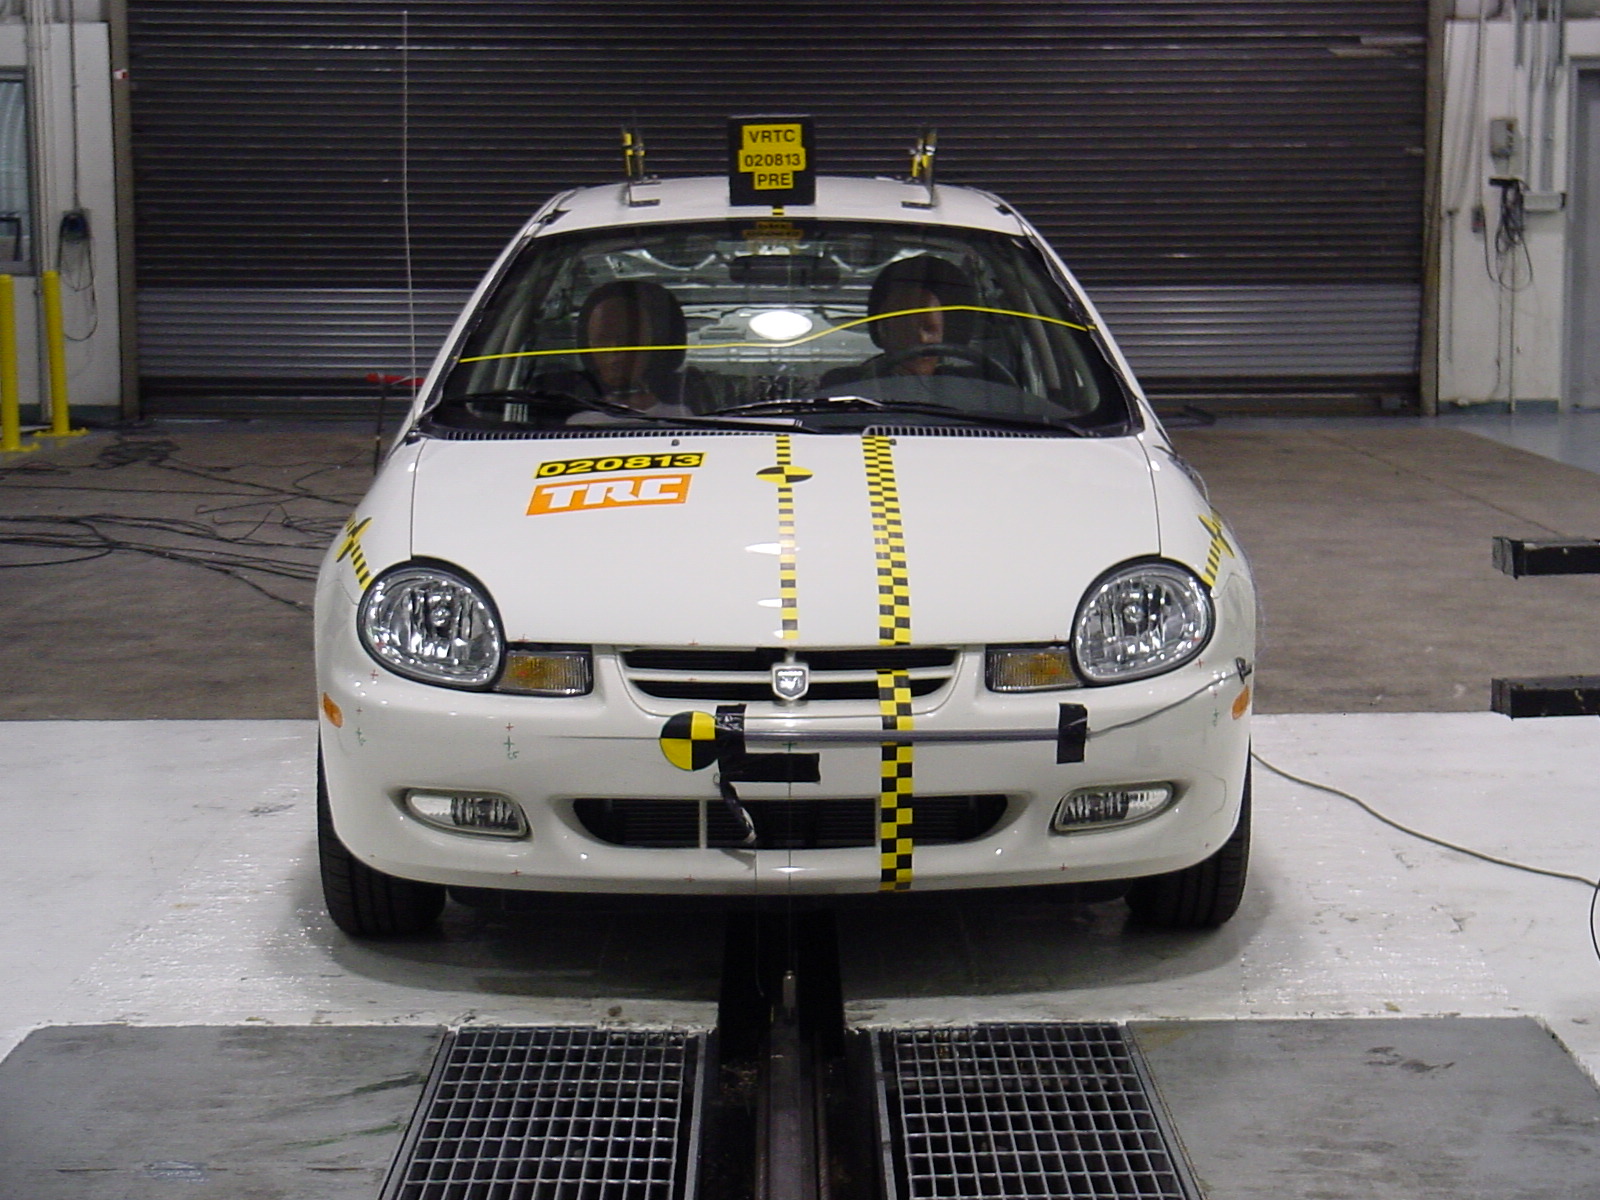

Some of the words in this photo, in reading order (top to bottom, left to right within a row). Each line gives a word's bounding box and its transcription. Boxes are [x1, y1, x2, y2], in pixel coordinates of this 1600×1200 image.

[748, 129, 796, 143] VRTC
[744, 153, 801, 167] 020813
[757, 173, 792, 187] PRE
[538, 454, 702, 477] 020813
[541, 477, 683, 509] TRC
